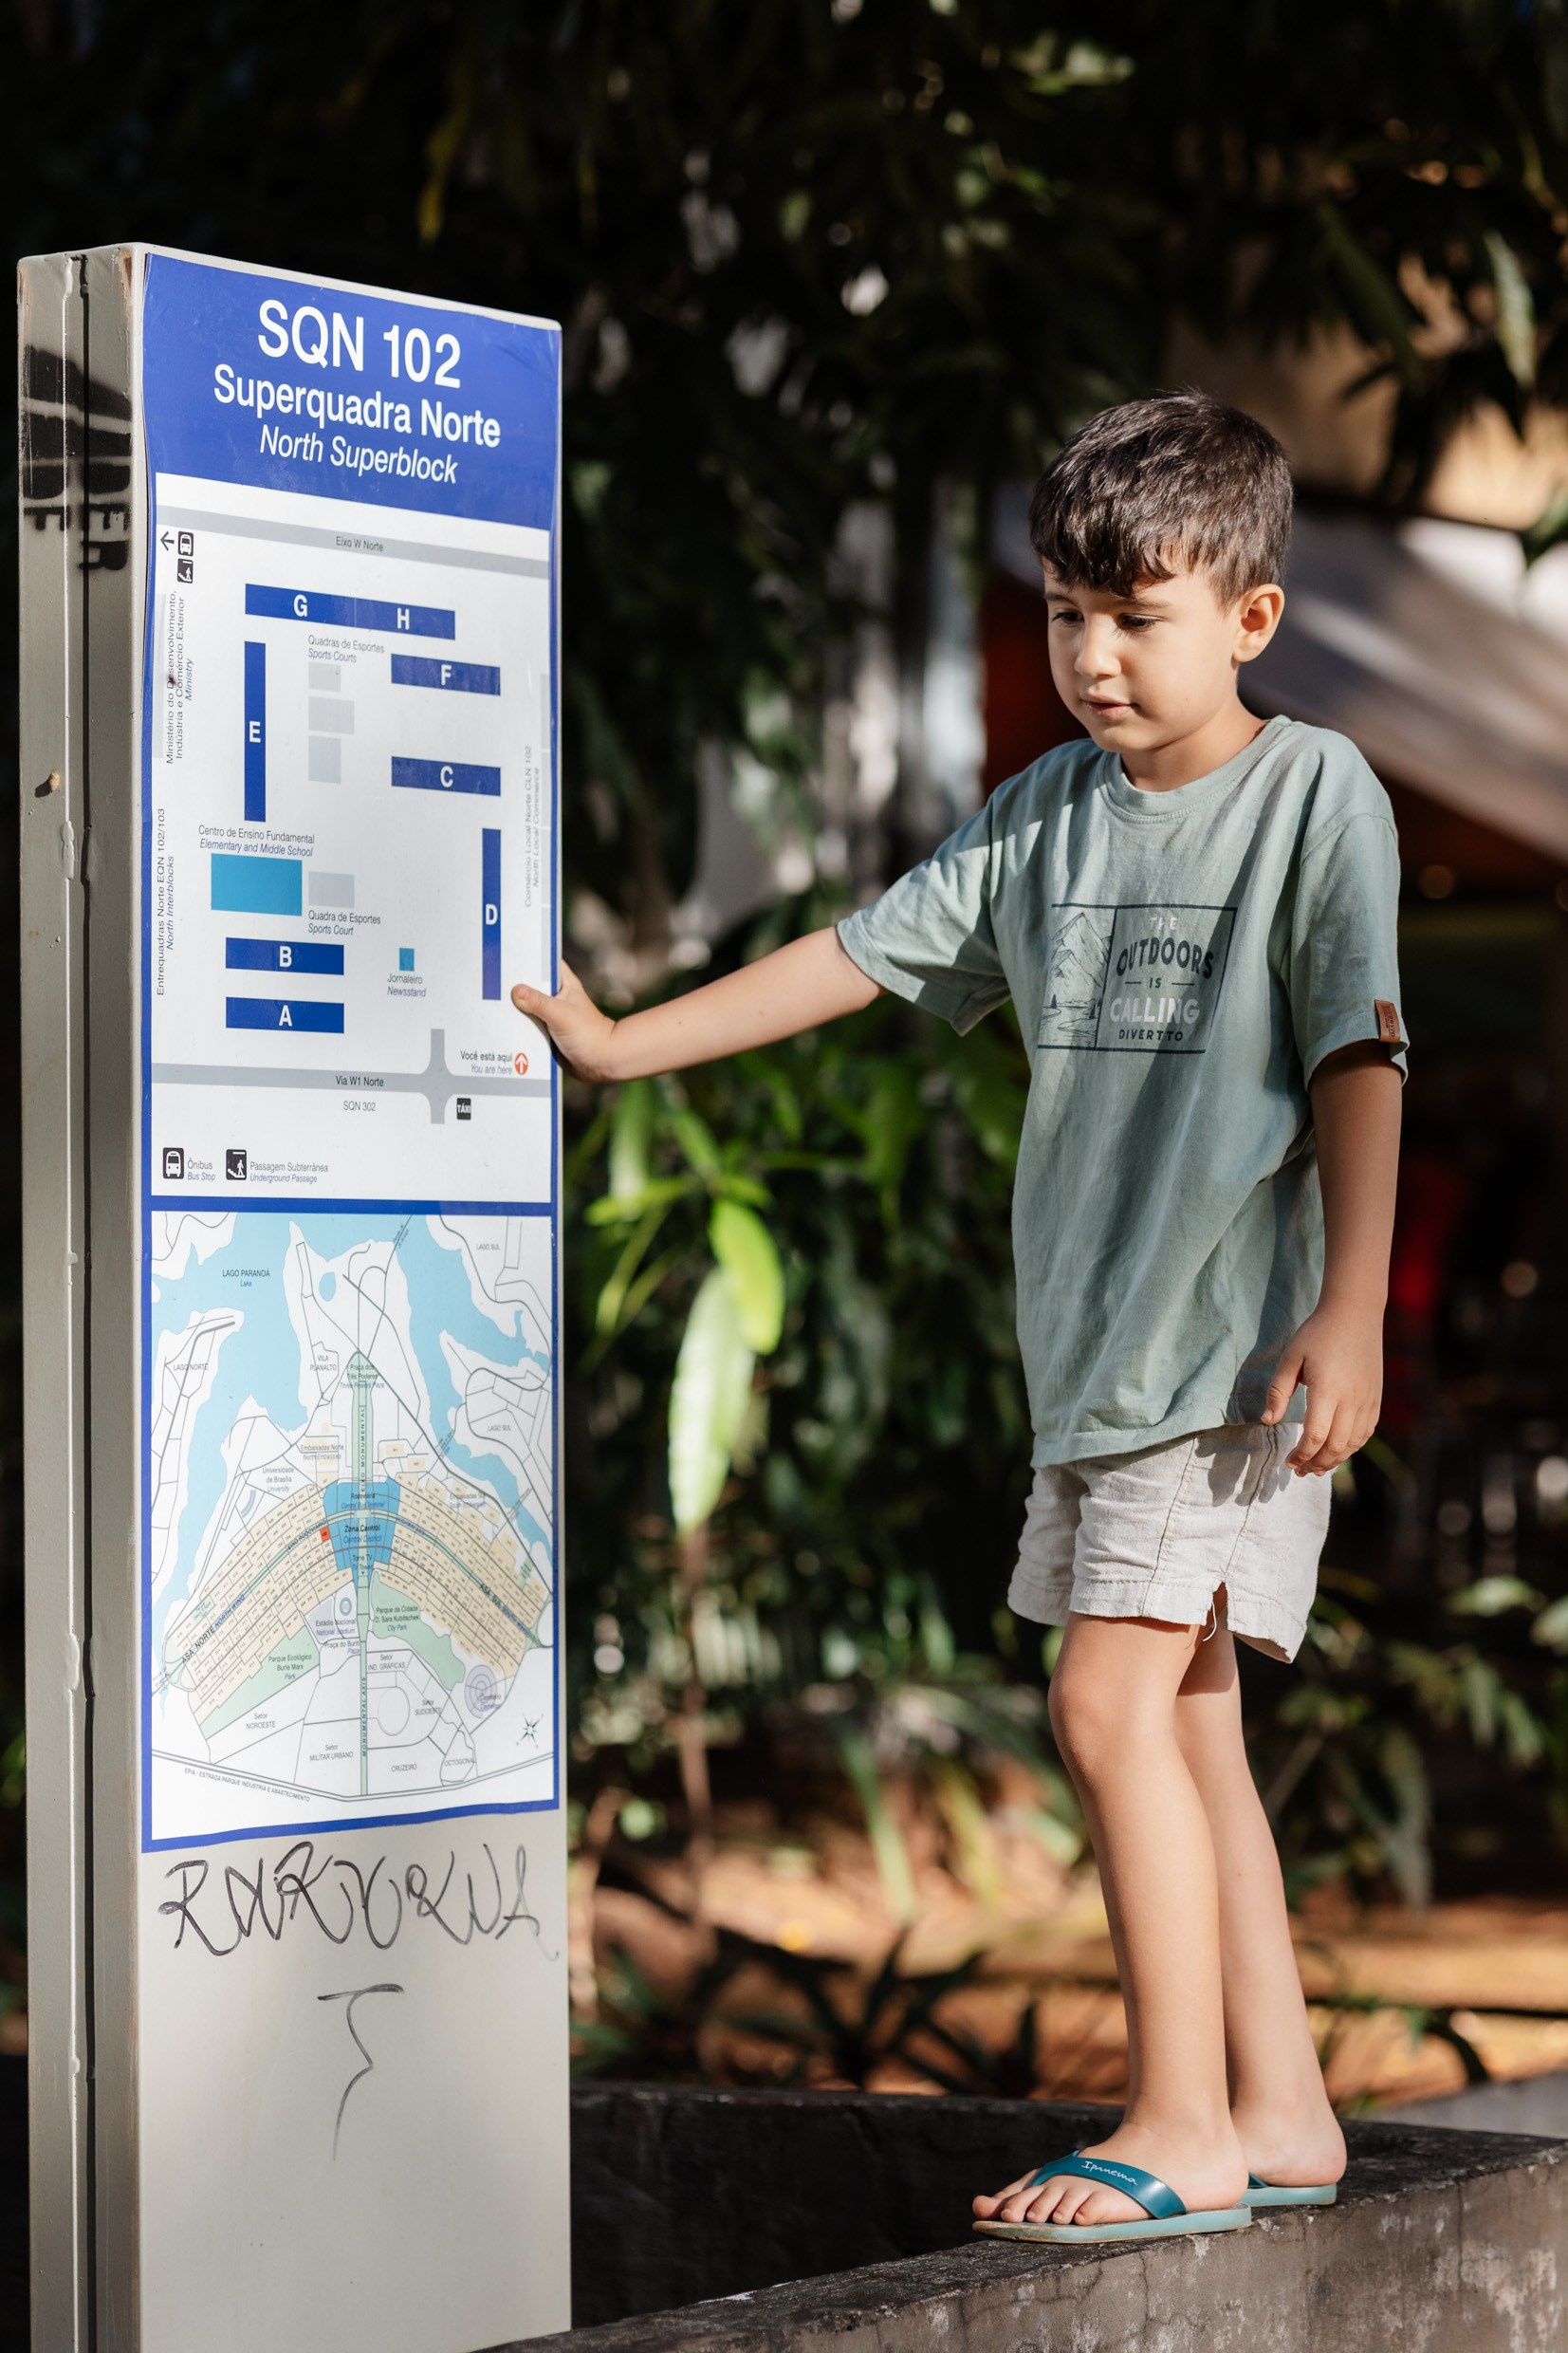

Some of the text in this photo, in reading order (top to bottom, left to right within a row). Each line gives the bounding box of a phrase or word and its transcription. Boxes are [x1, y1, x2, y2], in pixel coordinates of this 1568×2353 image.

[258, 299, 461, 388] SQN 102
[213, 363, 501, 448] Superquadra Norte
[260, 424, 458, 484] North Superblock
[336, 536, 384, 552] Eixo W Norte
[293, 594, 307, 617] G
[176, 598, 185, 640] Exterior
[397, 607, 410, 630] H
[308, 635, 384, 654] Quadras de Esportes
[308, 648, 357, 663] Sports Courts
[185, 658, 194, 701] Ministry
[441, 664, 452, 685] F
[169, 693, 175, 708] do
[249, 721, 261, 743] E
[440, 766, 453, 788] C
[198, 824, 315, 844] Centro de Ensino Fundamental
[200, 839, 314, 857] Elementary and Middle School
[157, 856, 166, 883] EQN
[524, 857, 532, 907] Comércio
[308, 910, 381, 926] Quadra de Esportes
[486, 903, 498, 925] D
[307, 923, 354, 936] Sports Court
[1150, 917, 1178, 931] THE
[279, 946, 292, 968] B
[1116, 937, 1214, 979] OUTDOORS
[387, 973, 423, 985] Jornaleiro
[1149, 977, 1161, 989] IS
[387, 986, 427, 997] Newsstand
[278, 1005, 293, 1027] A
[1110, 997, 1200, 1026] CALLING
[1118, 1028, 1184, 1042] DIVERTTO
[460, 1050, 513, 1064] Você está aqui
[470, 1064, 513, 1075] You are here
[336, 1075, 384, 1087] Via W1 Norte
[343, 1101, 377, 1112] SQN 302
[187, 1157, 212, 1170] Ônibus
[249, 1161, 328, 1175] Passagem Subterrânea
[187, 1172, 216, 1182] Bus Stop
[249, 1174, 318, 1184] Underground Passage
[222, 1269, 270, 1278] LAGO PARANOÁ
[182, 1649, 194, 1664] ASA
[194, 1625, 215, 1650] NORTE
[215, 1607, 231, 1631] NORTH
[231, 1593, 246, 1610] WING
[246, 1721, 276, 1730] NOROESTE
[331, 1751, 354, 1760] URBANO
[184, 1768, 195, 1776] EPIA
[199, 1771, 221, 1782] ESTRADA
[222, 1776, 241, 1786] PARQUE
[271, 1788, 310, 1803] ABASTECIMENTO
[1080, 2160, 1138, 2186] Ipanema
